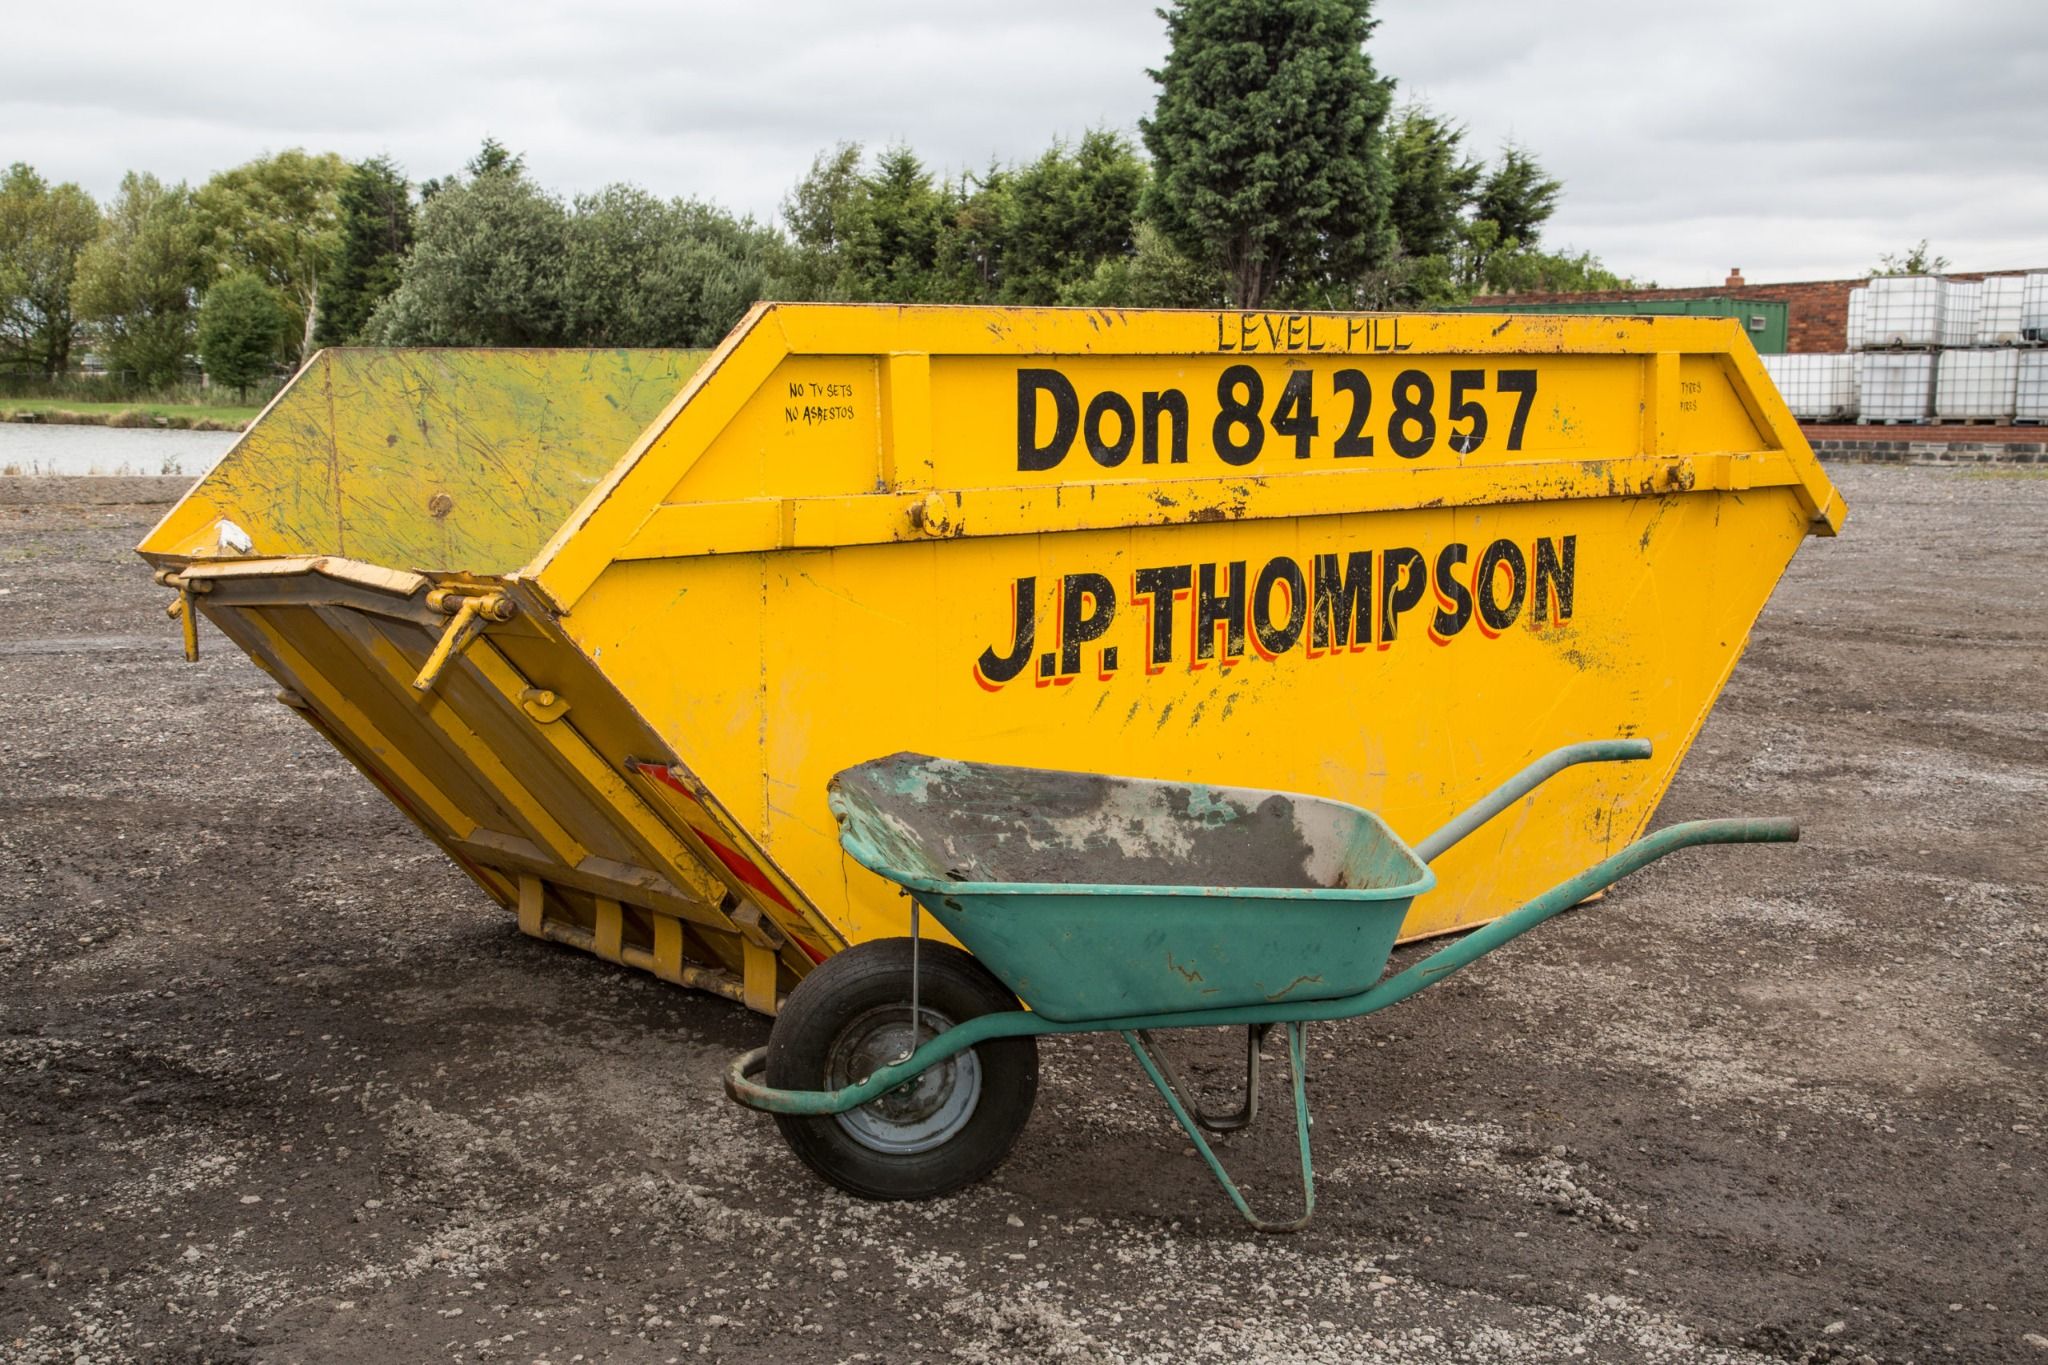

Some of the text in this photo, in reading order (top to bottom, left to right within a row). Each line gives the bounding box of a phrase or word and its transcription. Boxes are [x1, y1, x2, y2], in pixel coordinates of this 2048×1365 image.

[1218, 313, 1413, 351] LEVEL FILL
[789, 382, 804, 398] NO
[827, 383, 853, 397] SETS
[785, 405, 855, 425] NO ASBESTOS
[1017, 364, 1538, 472] Don 842857
[1131, 535, 1576, 677] THOMPSON
